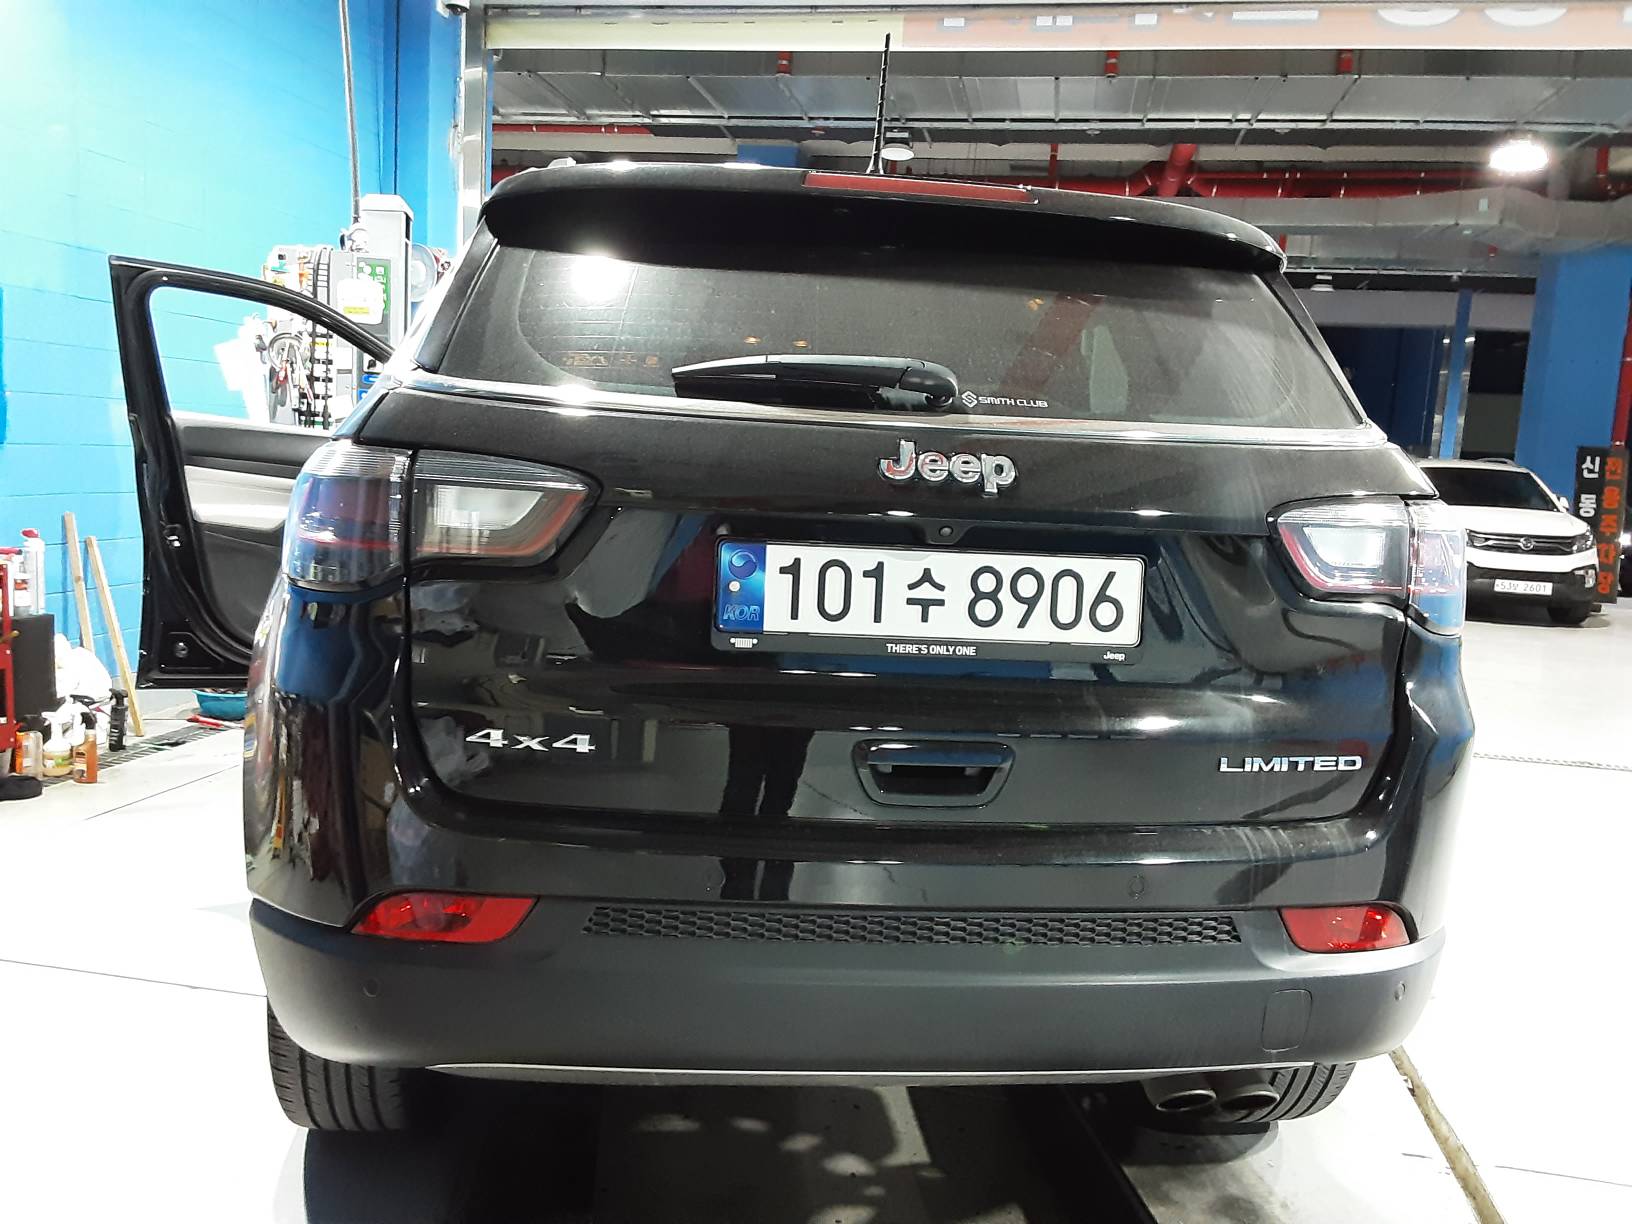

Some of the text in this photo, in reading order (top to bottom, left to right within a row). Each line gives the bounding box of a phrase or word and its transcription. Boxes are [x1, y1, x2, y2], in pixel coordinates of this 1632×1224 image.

[978, 396, 1048, 408] SMITH CLUB
[878, 439, 1017, 493] Jeep
[778, 557, 1125, 633] 101수 8906
[1523, 583, 1546, 593] 2601
[723, 603, 760, 621] KOR
[886, 643, 977, 656] THERE'S ONLY ONE
[1103, 651, 1126, 661] Jeep
[465, 729, 596, 753] 4x4
[1219, 755, 1363, 772] LIMITED
